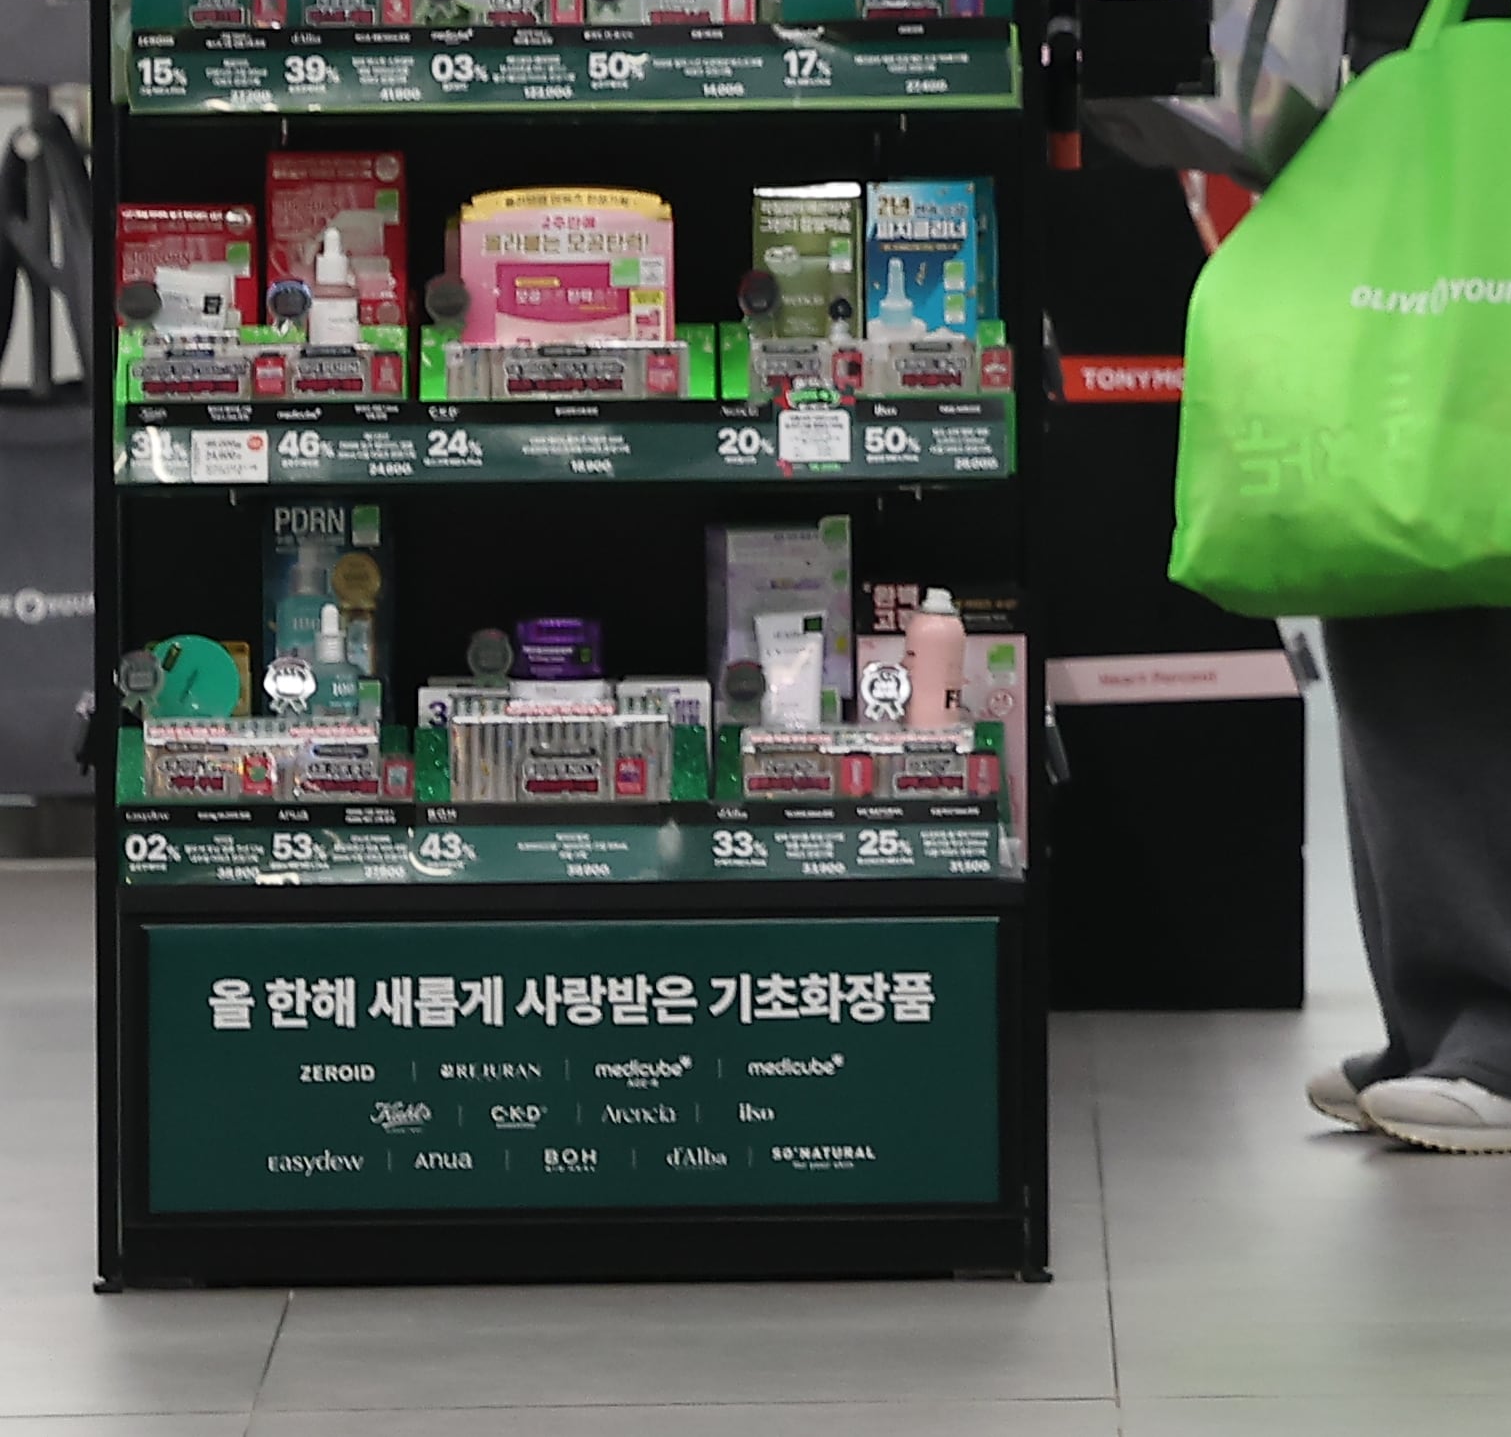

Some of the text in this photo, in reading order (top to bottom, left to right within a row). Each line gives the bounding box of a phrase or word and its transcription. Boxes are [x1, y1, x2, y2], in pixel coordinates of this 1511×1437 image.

[275, 507, 344, 533] PDRN
[208, 972, 936, 1030] 올 한해 새롭게 사랑받은 기초화장품
[300, 1064, 376, 1082] ZEROID
